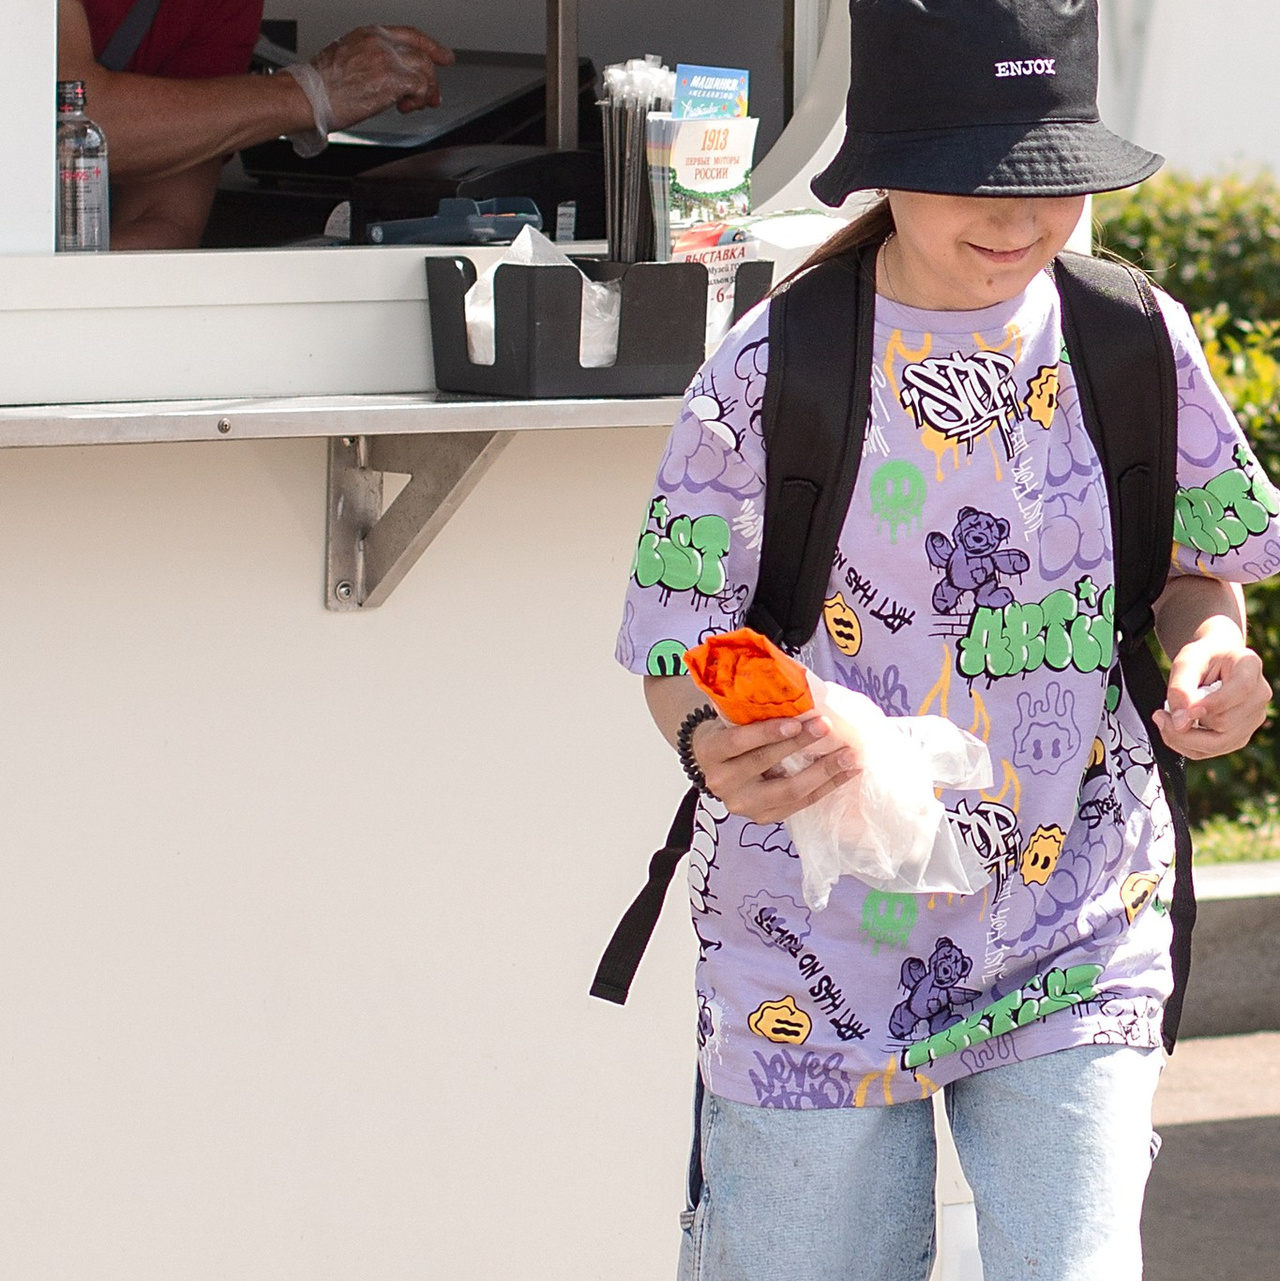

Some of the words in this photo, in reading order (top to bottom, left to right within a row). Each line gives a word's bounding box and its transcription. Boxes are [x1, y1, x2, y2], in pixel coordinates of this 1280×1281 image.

[994, 58, 1057, 78] ENJOY
[701, 128, 730, 152] 1913
[694, 166, 730, 181] РОССИИ
[684, 246, 746, 265] ВЫСТАВКА
